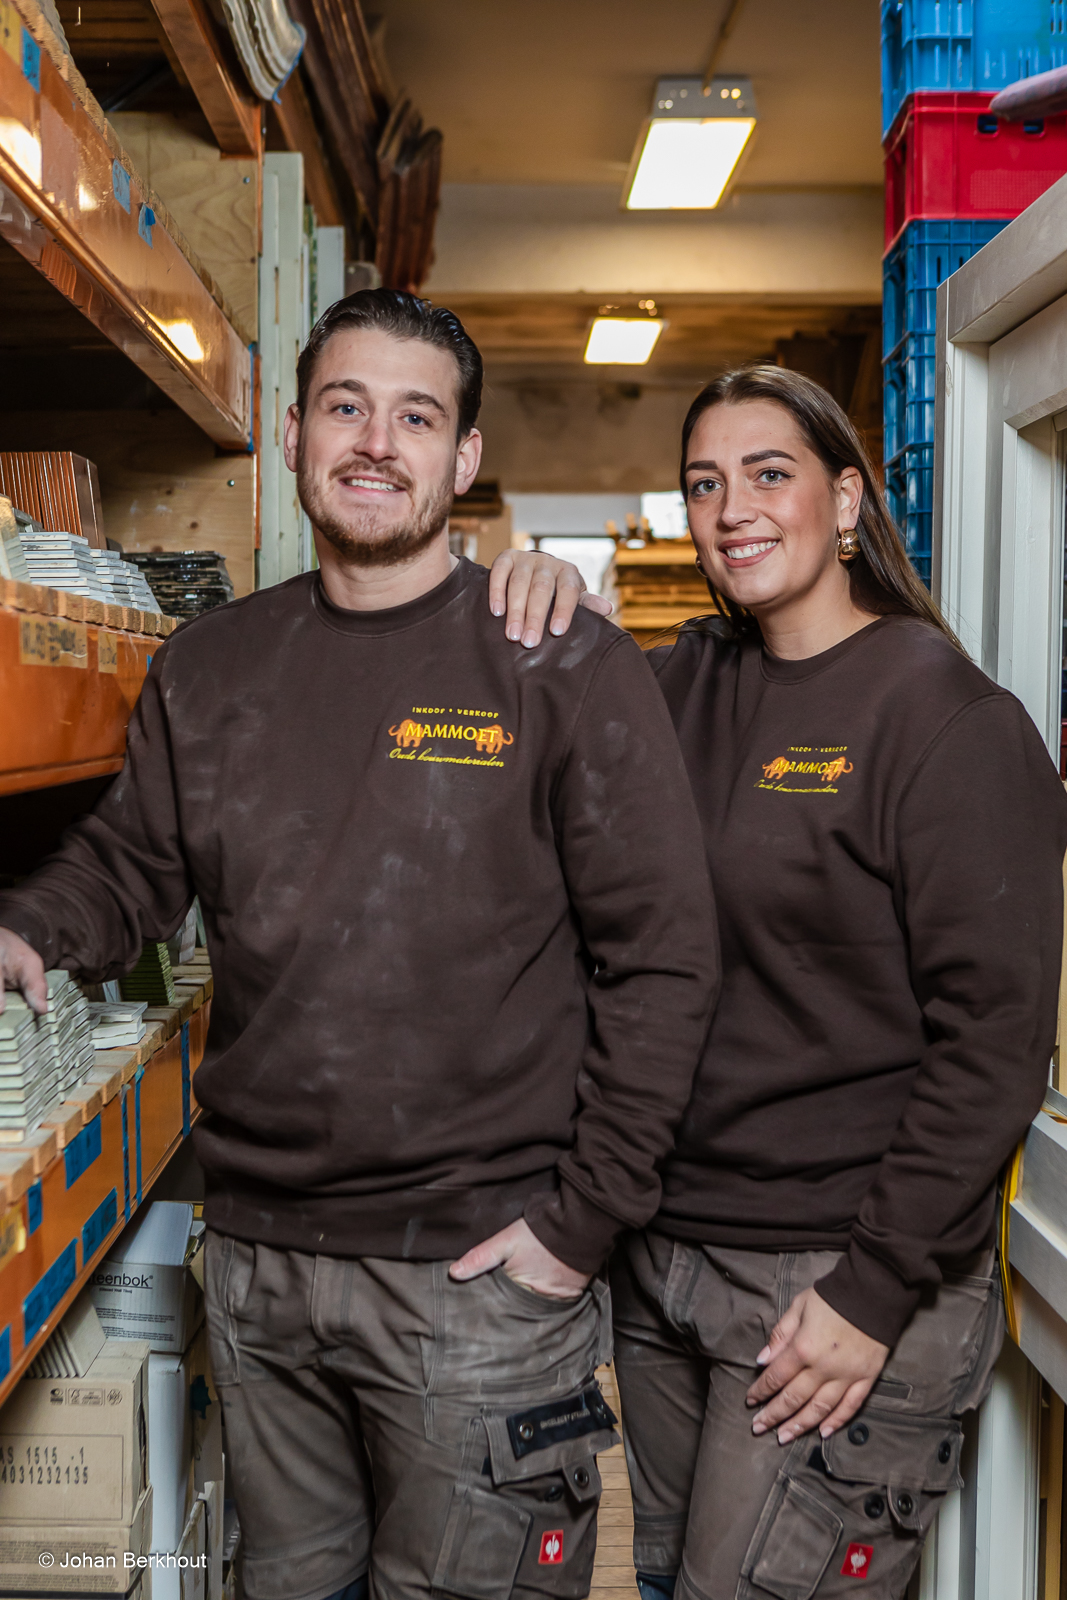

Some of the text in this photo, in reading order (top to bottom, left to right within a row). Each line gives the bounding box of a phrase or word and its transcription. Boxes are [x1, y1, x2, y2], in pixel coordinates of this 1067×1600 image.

[457, 708, 499, 719] VERKOOP
[405, 723, 499, 743] MAMMOET
[26, 1446, 57, 1465] 1515
[1, 1465, 88, 1484] 4031232135
